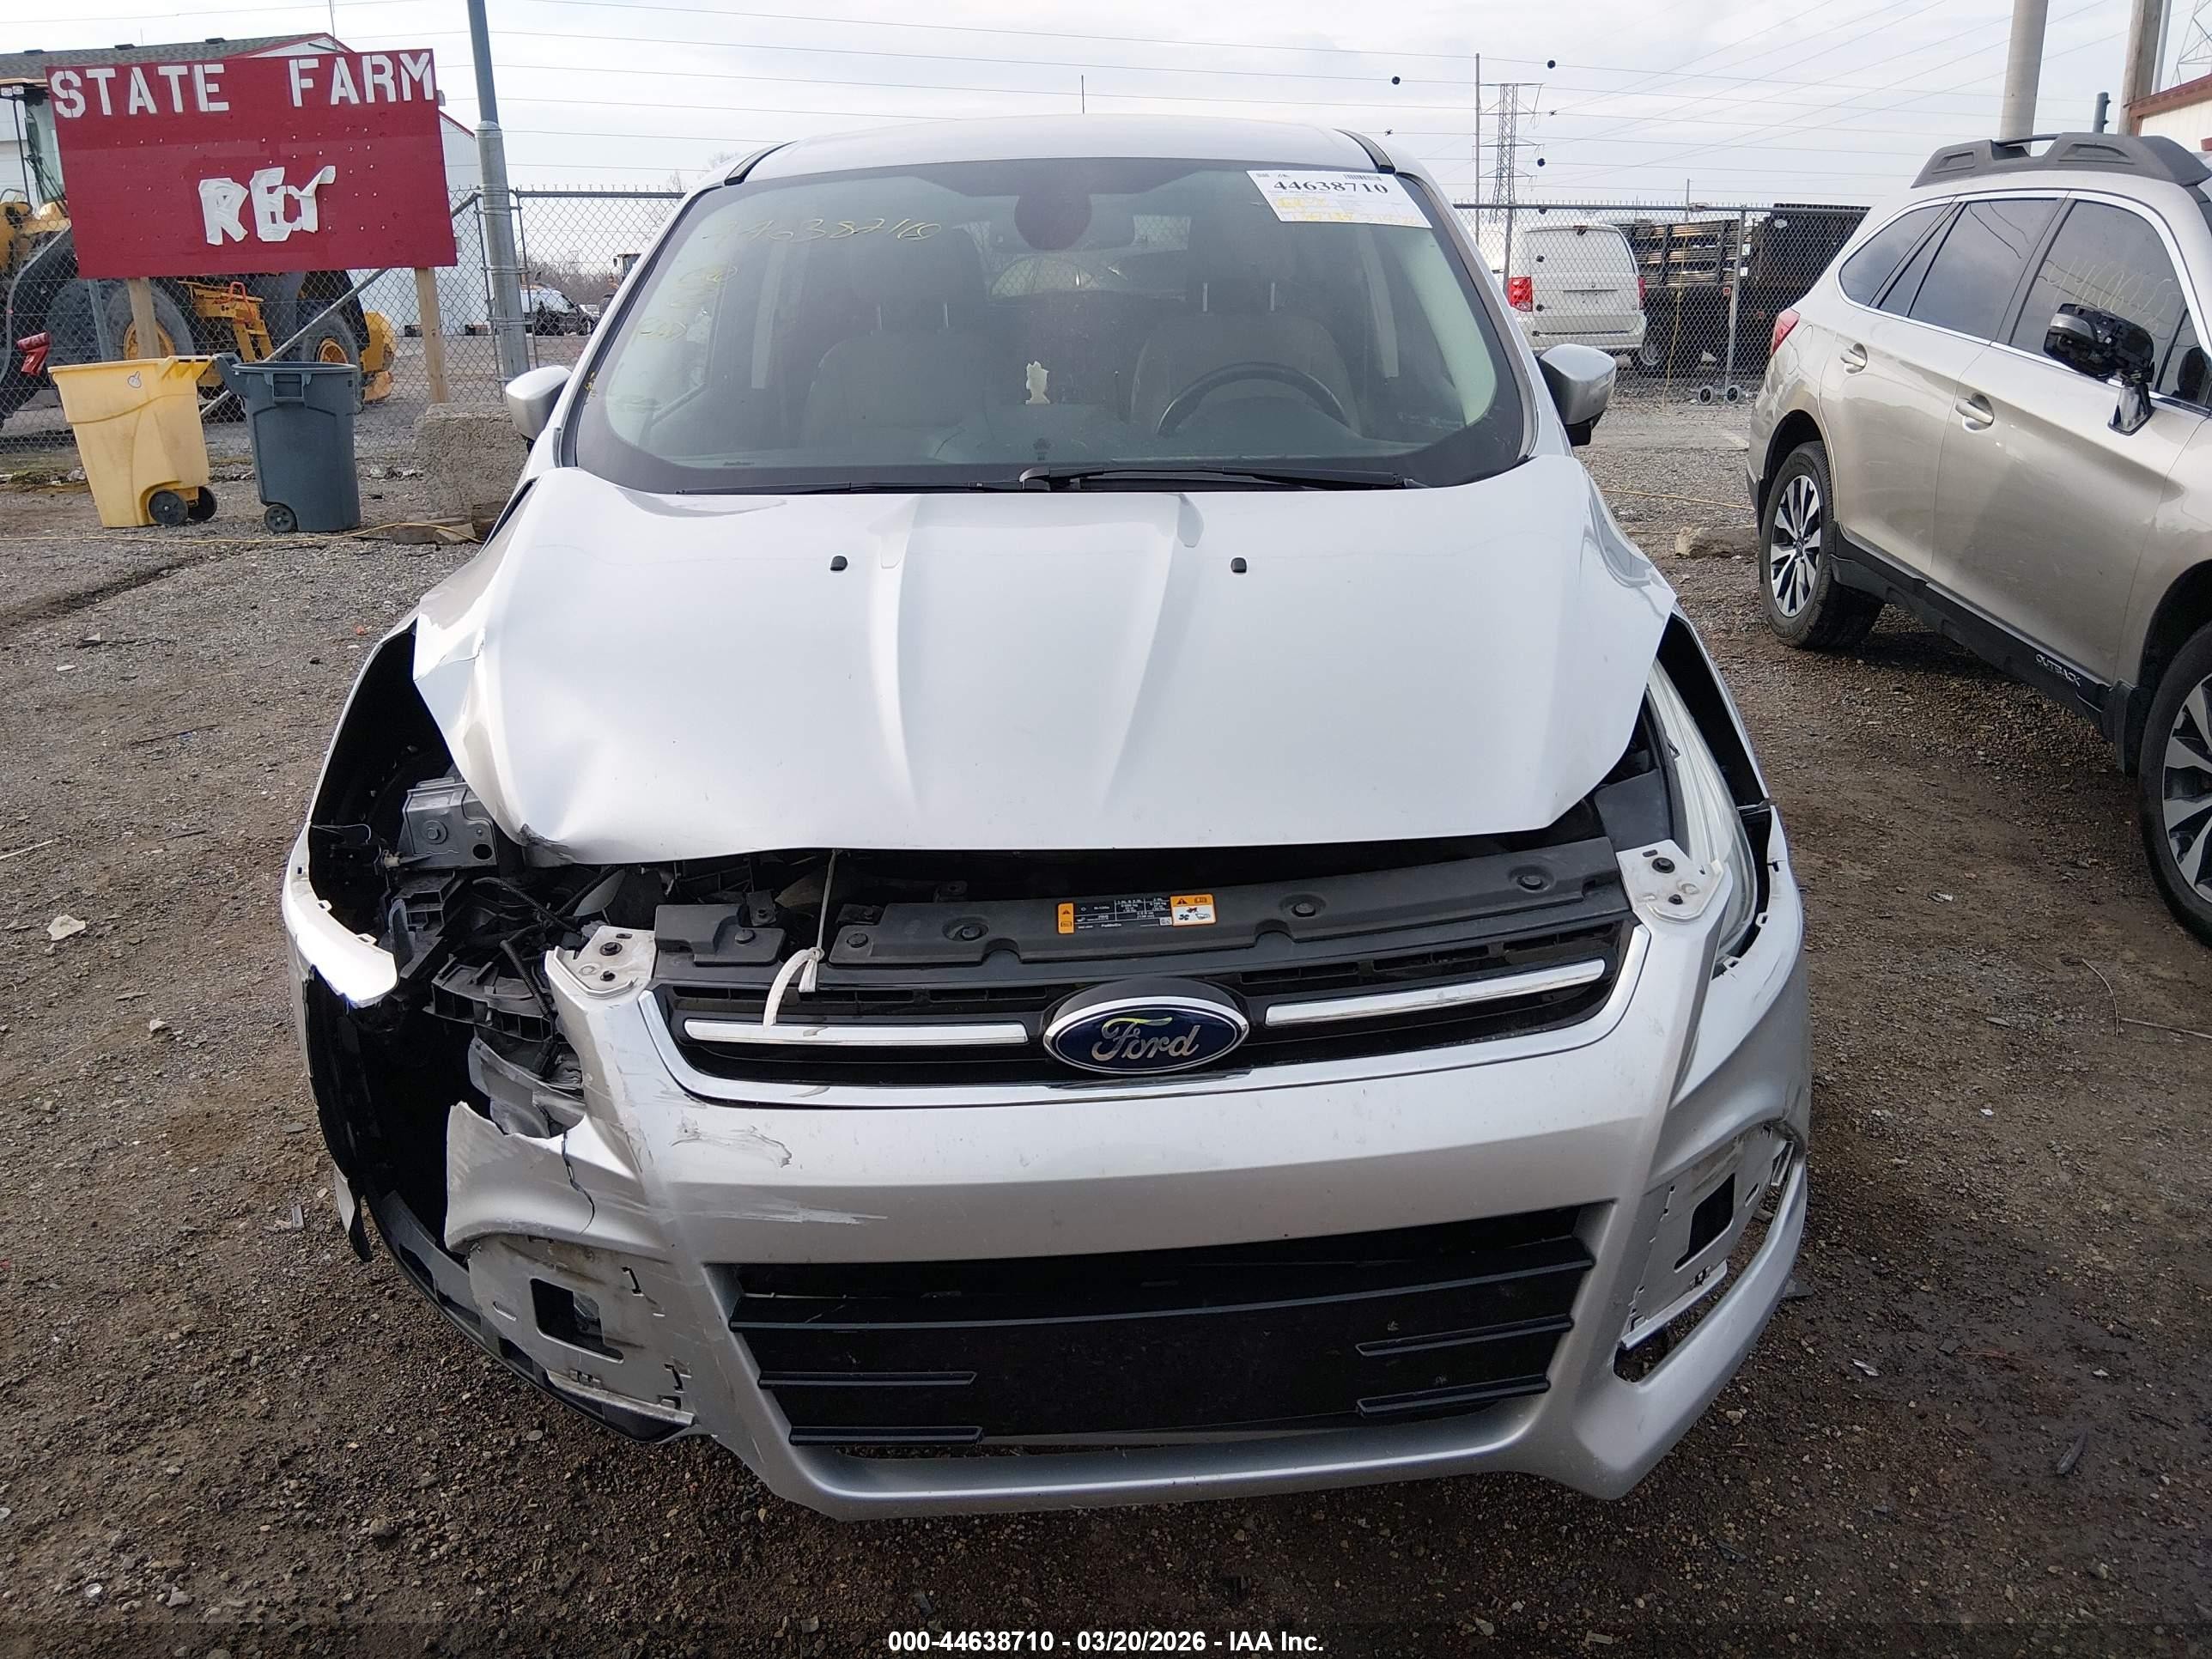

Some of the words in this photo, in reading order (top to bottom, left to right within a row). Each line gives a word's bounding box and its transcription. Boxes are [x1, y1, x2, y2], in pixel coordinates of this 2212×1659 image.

[51, 63, 229, 118] STATE
[288, 52, 434, 108] FARM
[1273, 179, 1389, 194] 44638710
[2035, 653, 2081, 687] OUTBACK
[1091, 1017, 1200, 1061] Ford
